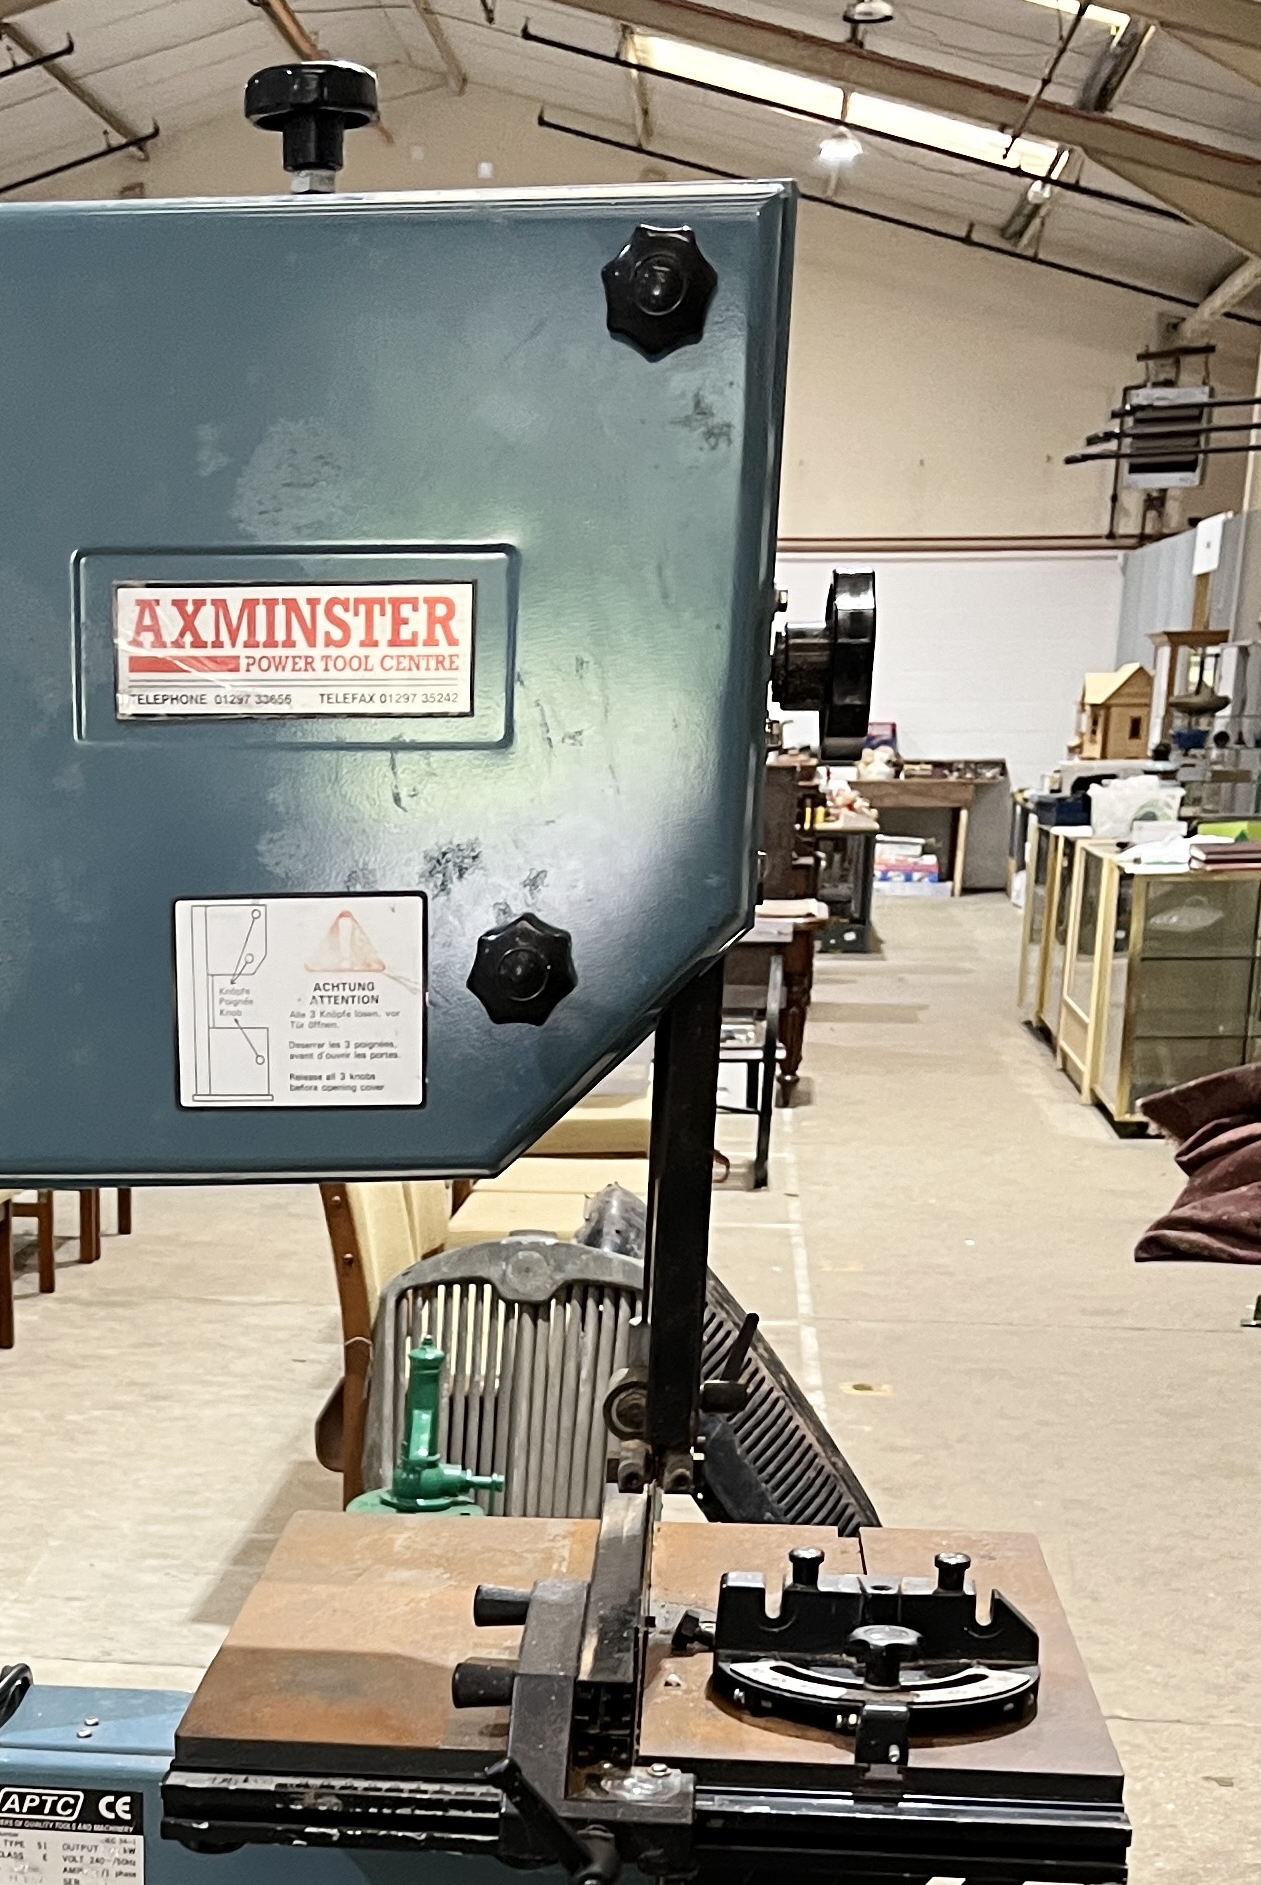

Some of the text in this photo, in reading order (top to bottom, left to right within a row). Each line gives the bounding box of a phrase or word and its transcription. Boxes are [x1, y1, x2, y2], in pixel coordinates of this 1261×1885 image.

[129, 597, 460, 649] AXMINSTER
[245, 654, 460, 673] POWER TOOL CENTRE
[214, 694, 251, 705] 01297
[319, 692, 459, 705] TELEFAX 01297 35242
[313, 982, 375, 992] ACHTUNG
[309, 995, 379, 1005] ATTENTION
[309, 1010, 316, 1019] 3
[344, 1040, 350, 1049] 3
[340, 1072, 346, 1081] 3
[321, 1085, 357, 1093] opening
[1, 1794, 75, 1816] APTC
[4, 1839, 25, 1849] TYPE
[62, 1843, 99, 1853] OUTPUT
[62, 1855, 85, 1864] VOLT
